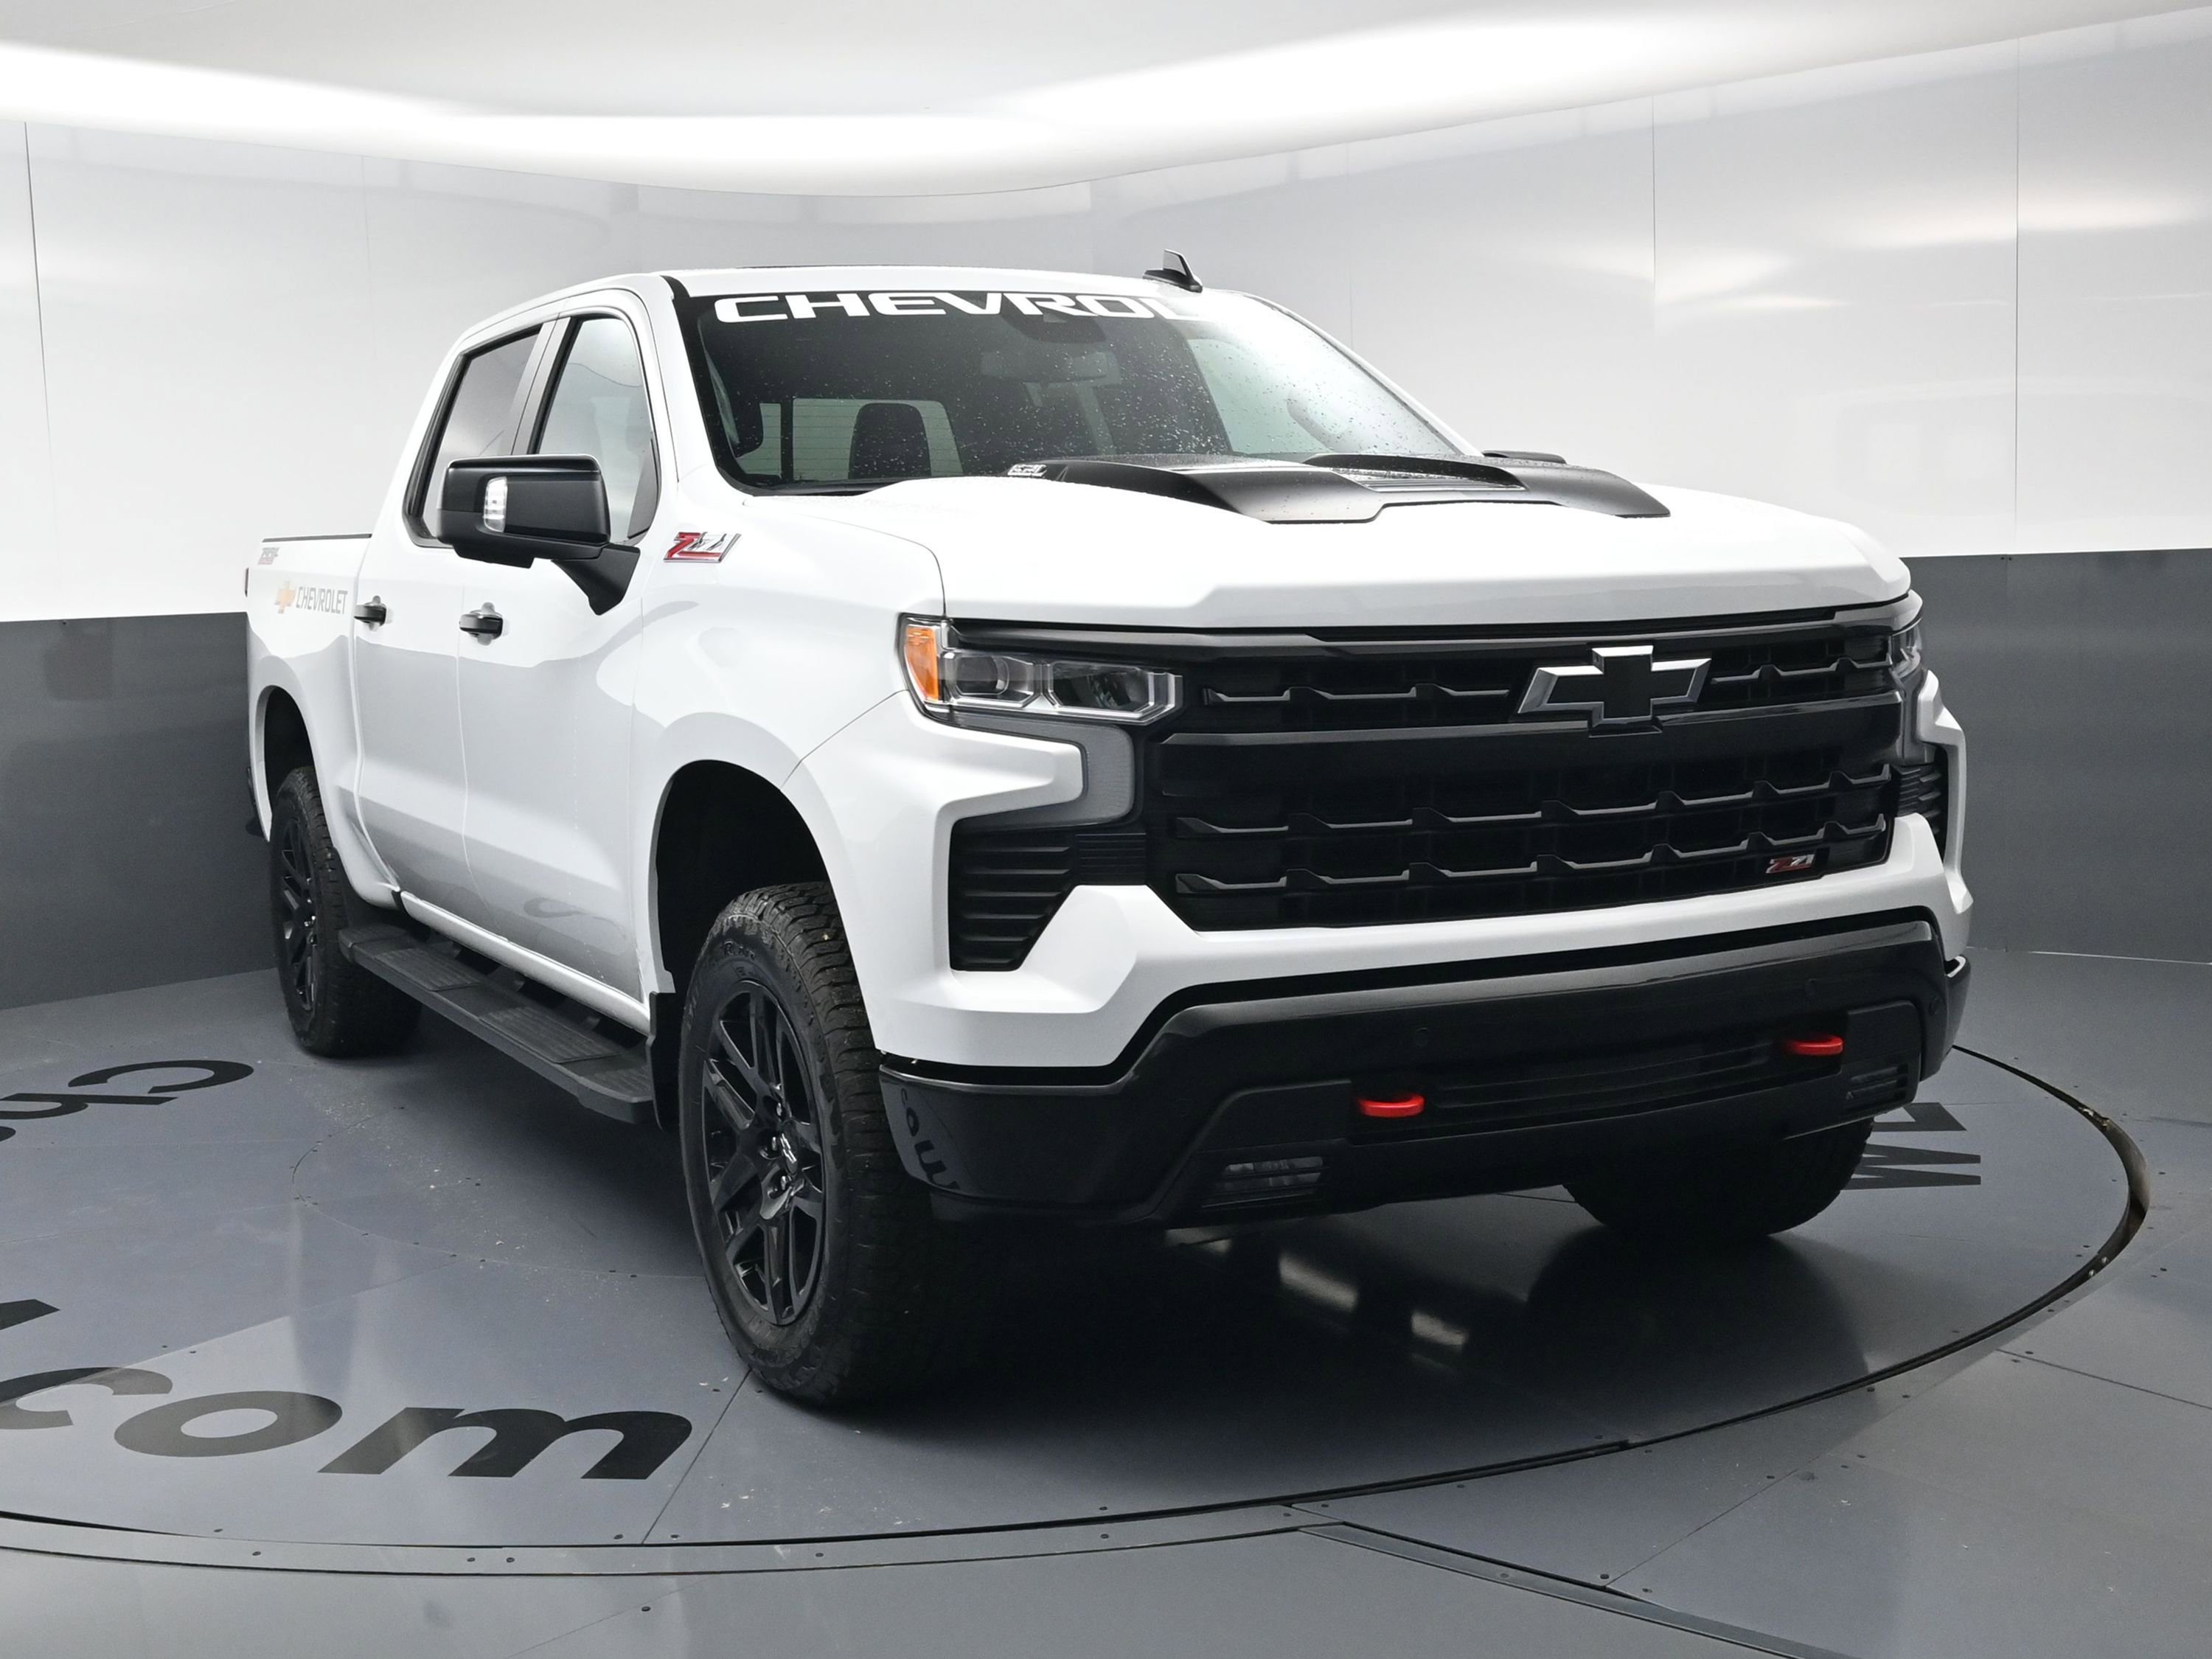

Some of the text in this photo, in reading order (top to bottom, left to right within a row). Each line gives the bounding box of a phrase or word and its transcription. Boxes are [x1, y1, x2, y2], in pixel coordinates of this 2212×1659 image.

[714, 291, 1209, 324] CHEVROL
[295, 585, 349, 614] CHEVROLET
[1765, 854, 1816, 874] Z71
[0, 1060, 254, 1142] Ch
